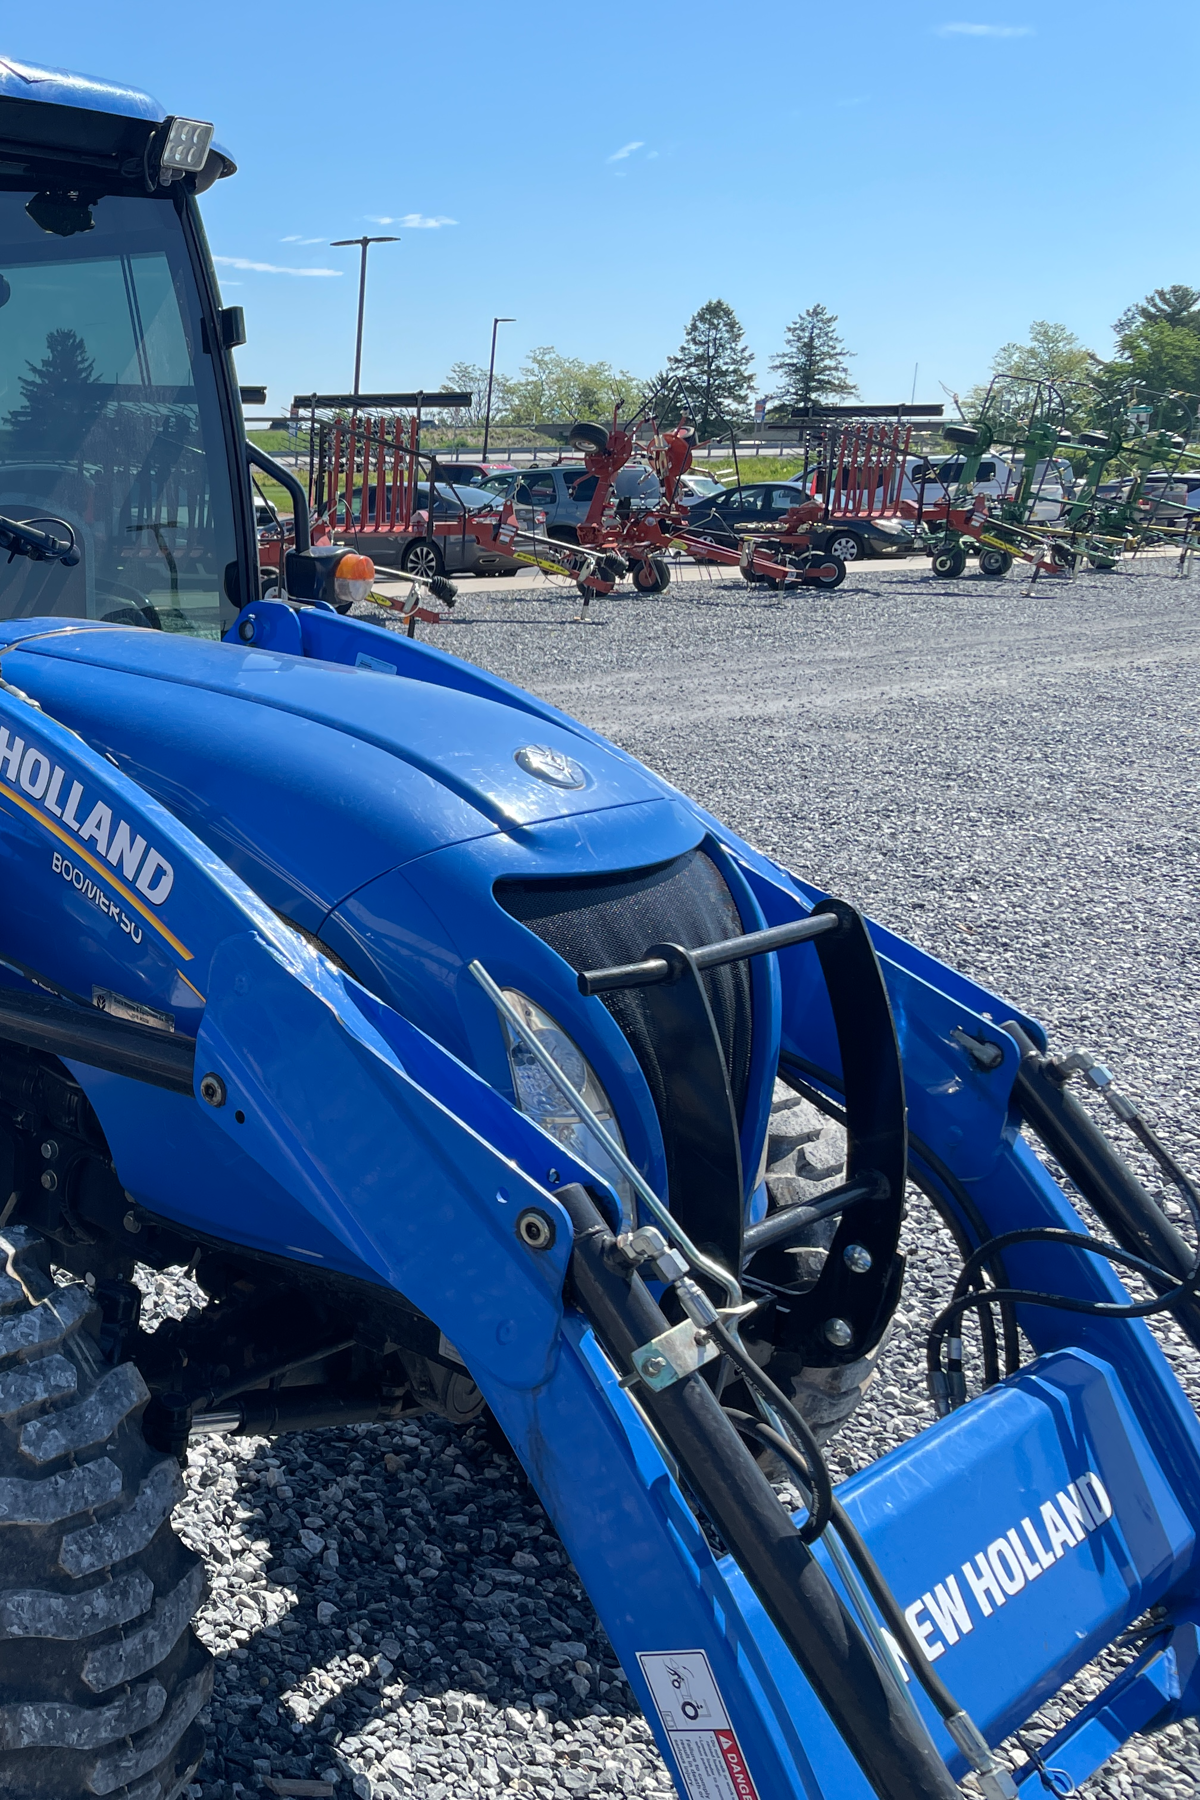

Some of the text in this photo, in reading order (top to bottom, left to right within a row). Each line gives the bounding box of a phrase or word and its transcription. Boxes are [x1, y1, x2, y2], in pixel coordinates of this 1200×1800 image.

[961, 1471, 1113, 1617] HOLLAND
[673, 1739, 686, 1764] serious
[680, 1739, 691, 1759] result
[690, 1768, 702, 1789] death
[698, 1790, 705, 1798] or
[685, 1739, 697, 1762] Failure
[698, 1773, 711, 1799] comply
